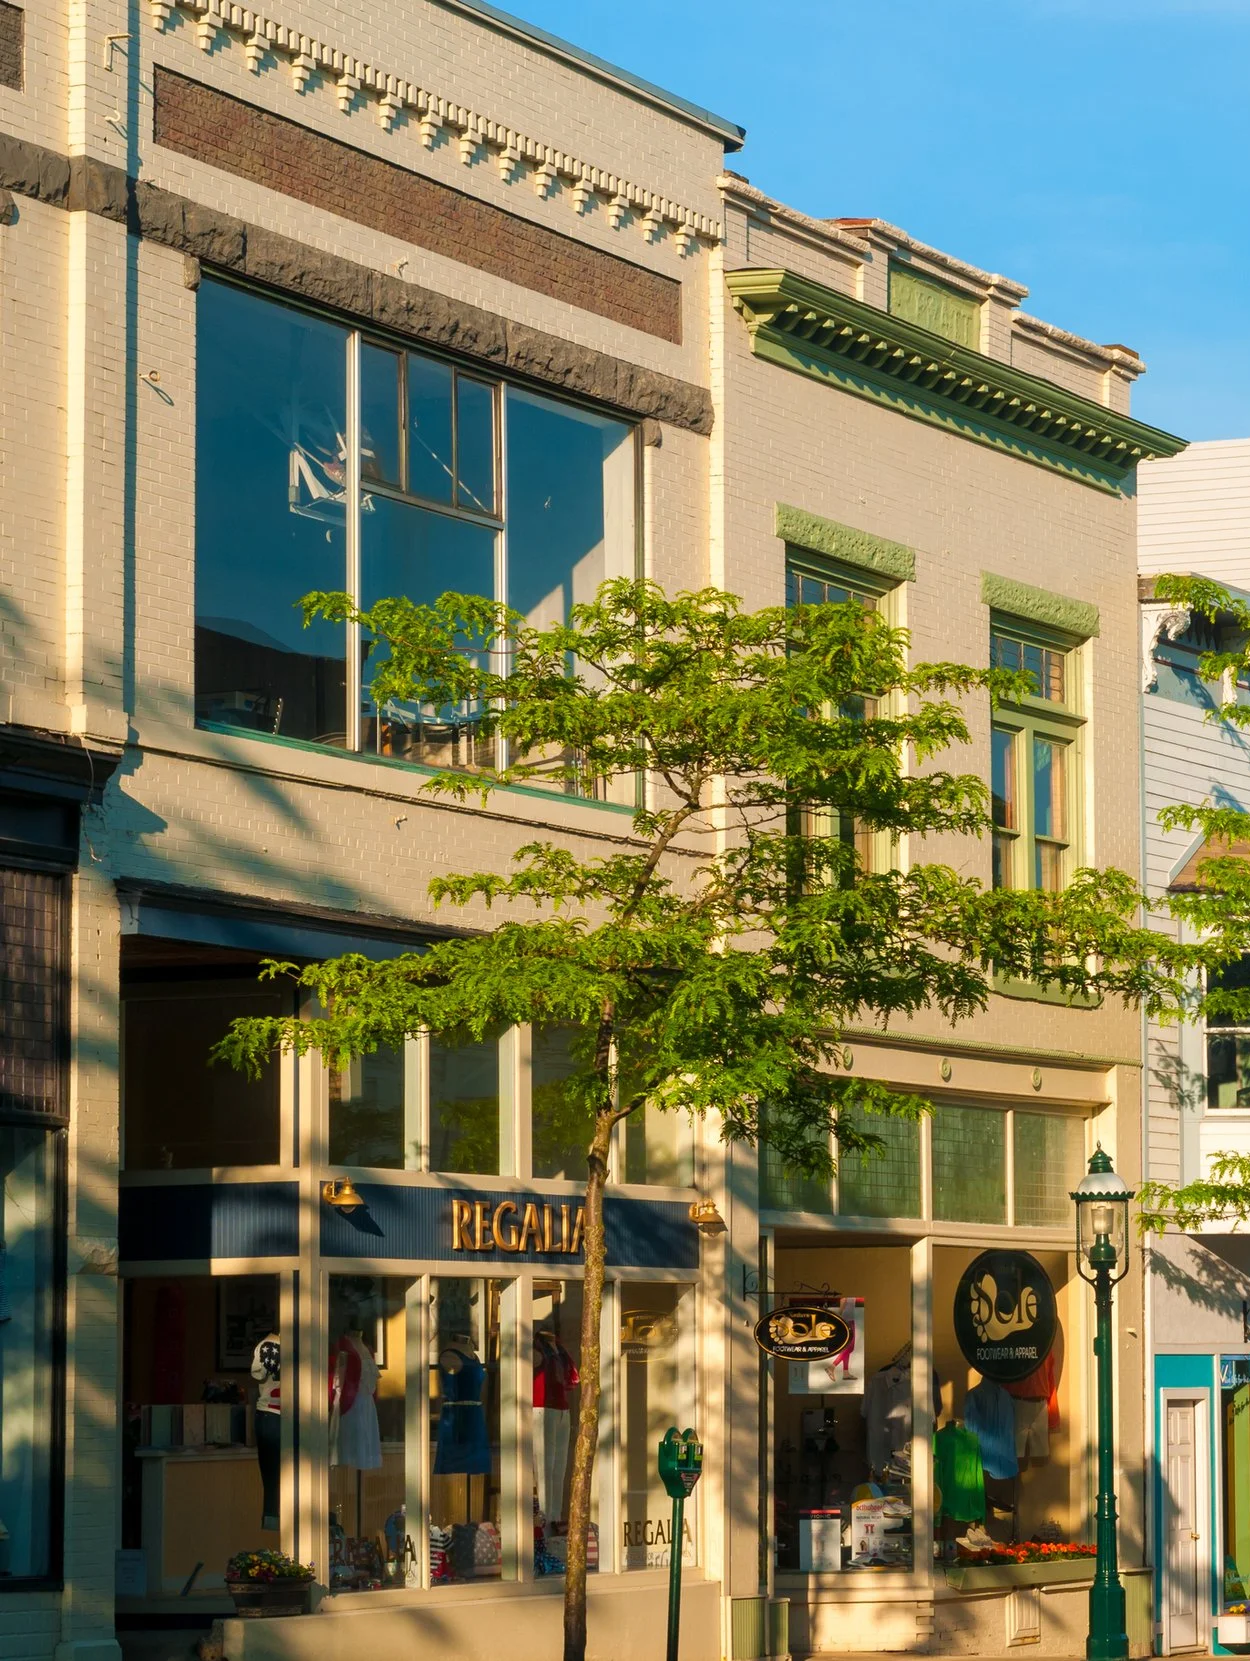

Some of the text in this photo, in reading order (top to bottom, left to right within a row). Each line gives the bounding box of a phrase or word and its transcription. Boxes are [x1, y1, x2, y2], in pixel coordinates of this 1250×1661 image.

[452, 1199, 587, 1254] REGALIA
[971, 1267, 1041, 1326] Sole
[770, 1314, 837, 1338] Sole
[773, 1345, 802, 1354] FOOTWEAR
[808, 1345, 830, 1354] APPAREL
[976, 1347, 1009, 1360] FOOTWEAR
[1015, 1346, 1039, 1359] APPAREL
[623, 1518, 692, 1548] REGALA
